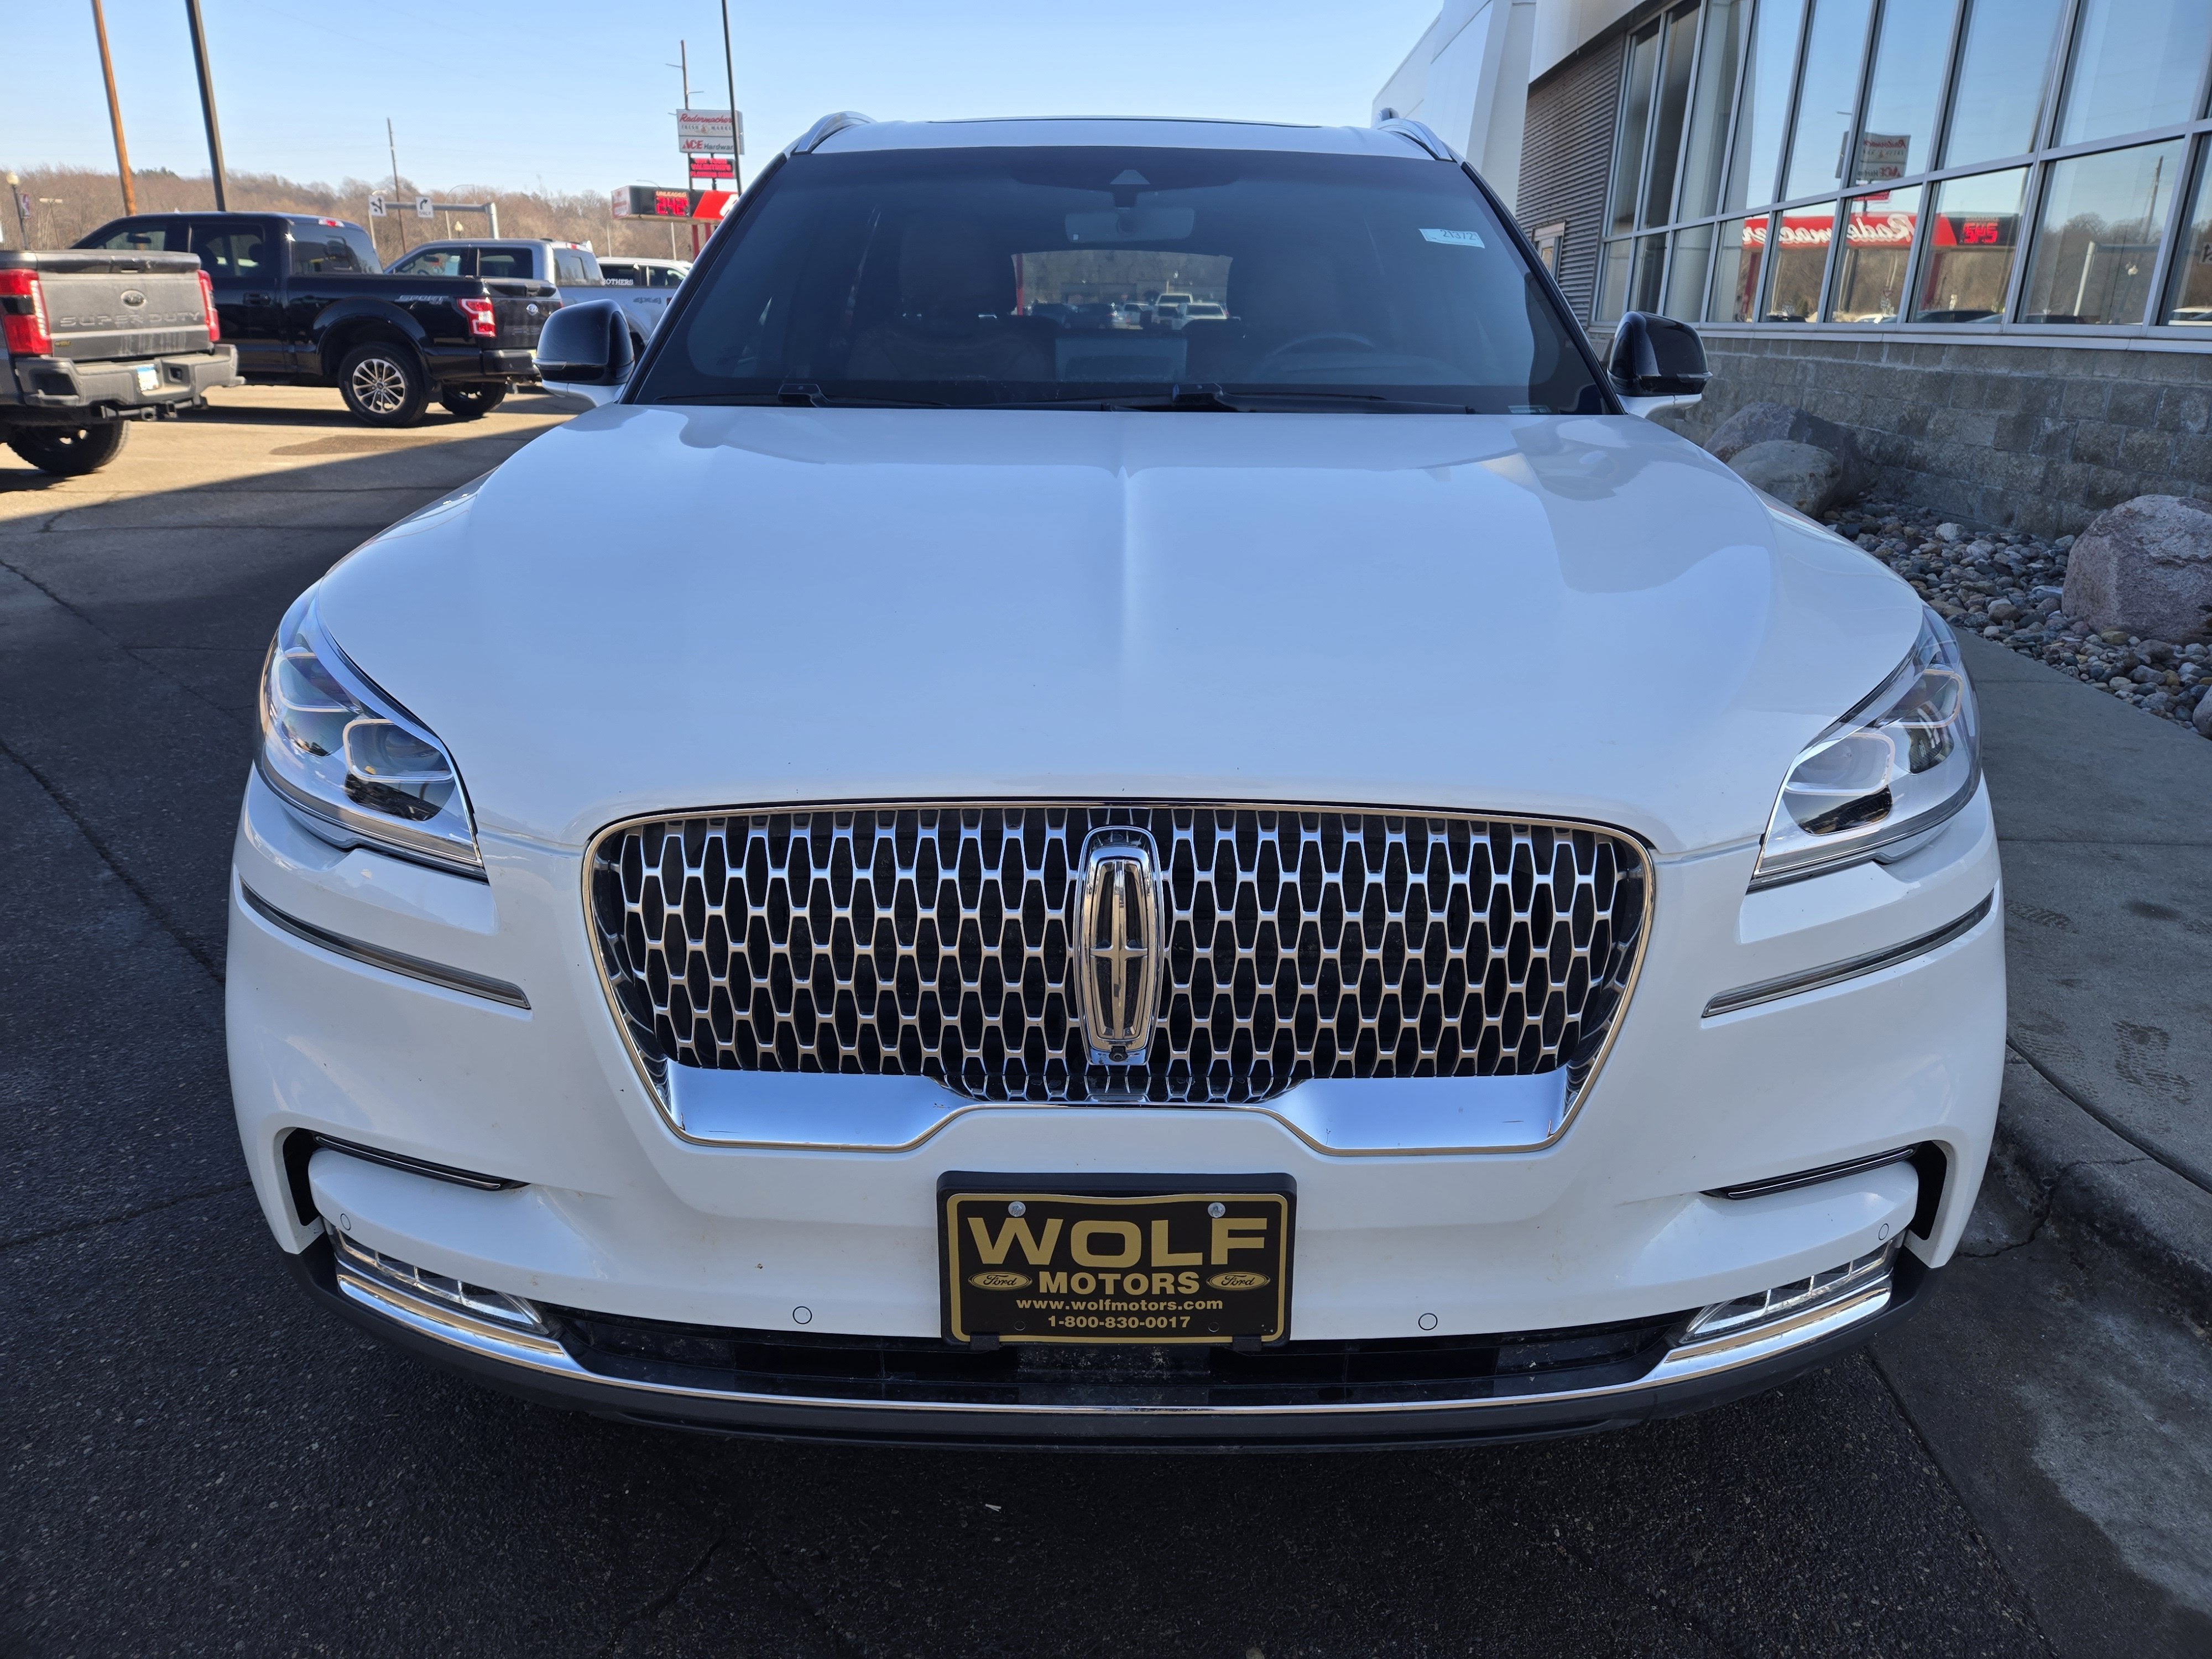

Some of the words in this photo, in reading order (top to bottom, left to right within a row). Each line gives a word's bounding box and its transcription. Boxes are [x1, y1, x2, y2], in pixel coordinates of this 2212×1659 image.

[682, 138, 703, 149] ACE
[60, 312, 144, 327] SUPER
[148, 311, 201, 324] DUTY
[968, 1217, 1267, 1267] WOLF
[983, 1274, 1018, 1286] Ford
[1039, 1271, 1200, 1295] MOTORS
[1220, 1274, 1255, 1286] Ford
[1016, 1299, 1223, 1311] www.wolfmotors.com
[1048, 1316, 1191, 1329] 1-800-830-0017
